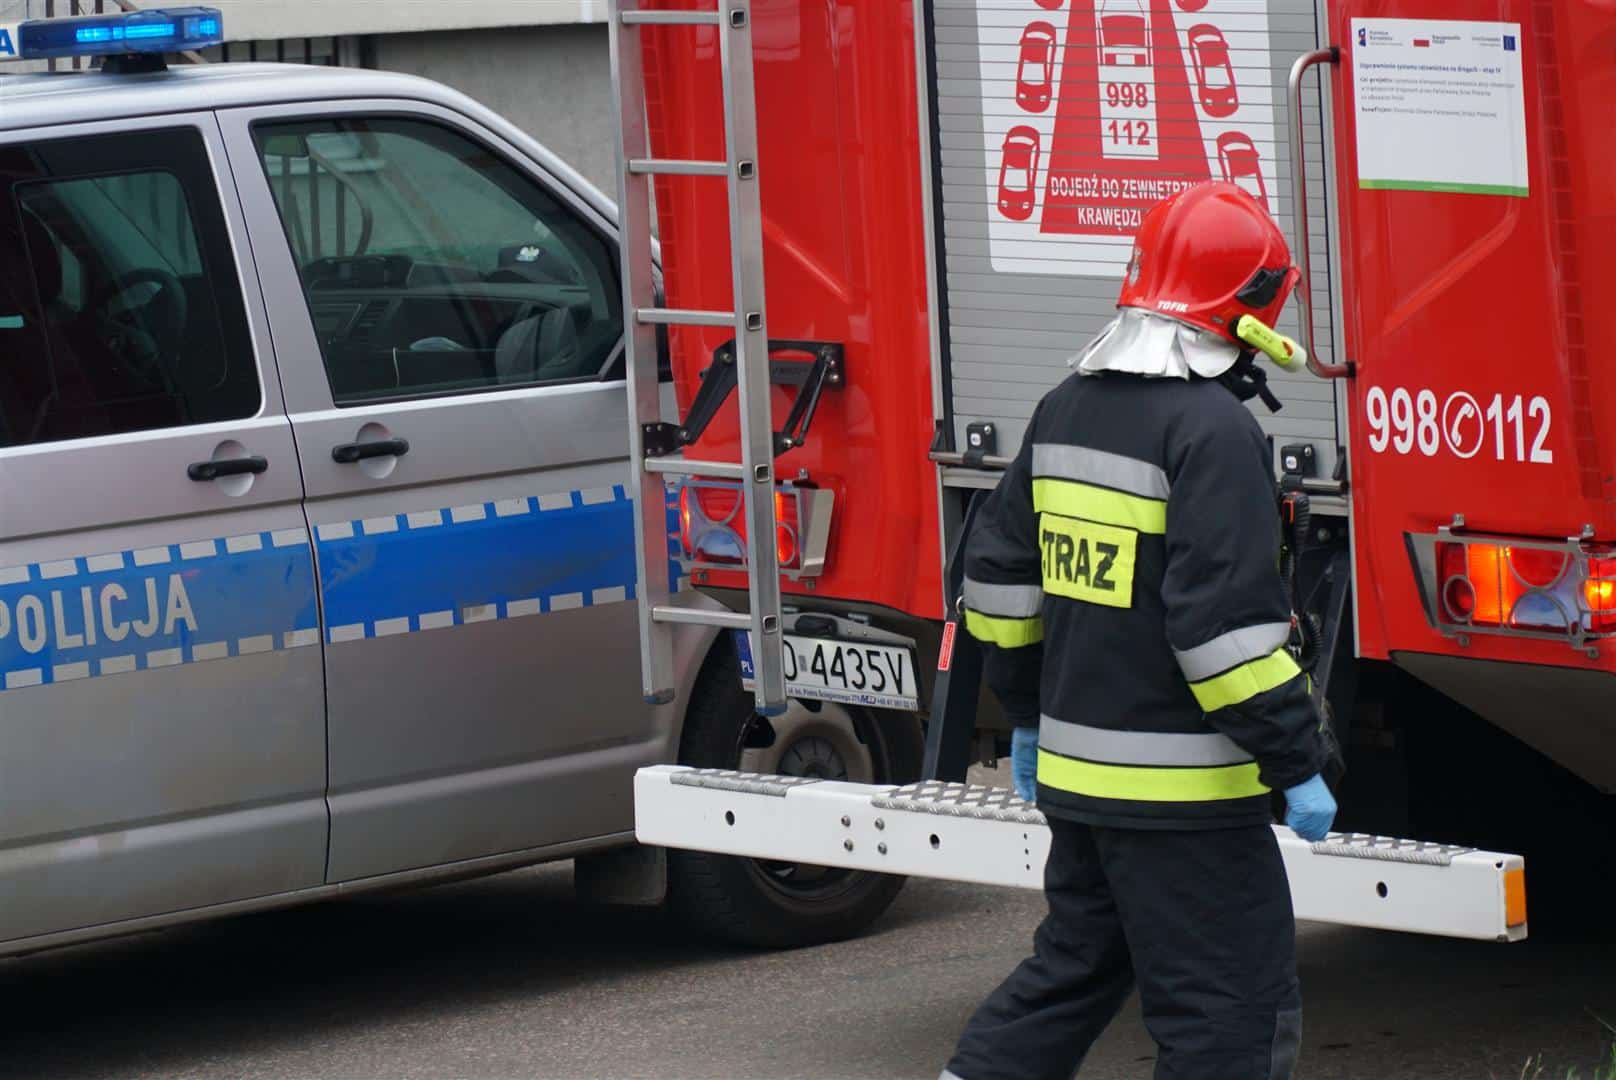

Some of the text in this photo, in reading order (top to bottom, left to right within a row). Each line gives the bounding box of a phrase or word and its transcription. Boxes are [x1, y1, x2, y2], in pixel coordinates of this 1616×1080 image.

[1106, 82, 1148, 109] 998
[1107, 120, 1150, 146] 112
[1102, 179, 1119, 198] DO
[1077, 207, 1142, 231] KRAWĘDZI
[1366, 385, 1553, 464] 998 112
[740, 660, 753, 673] PL
[811, 644, 903, 695] 4435V
